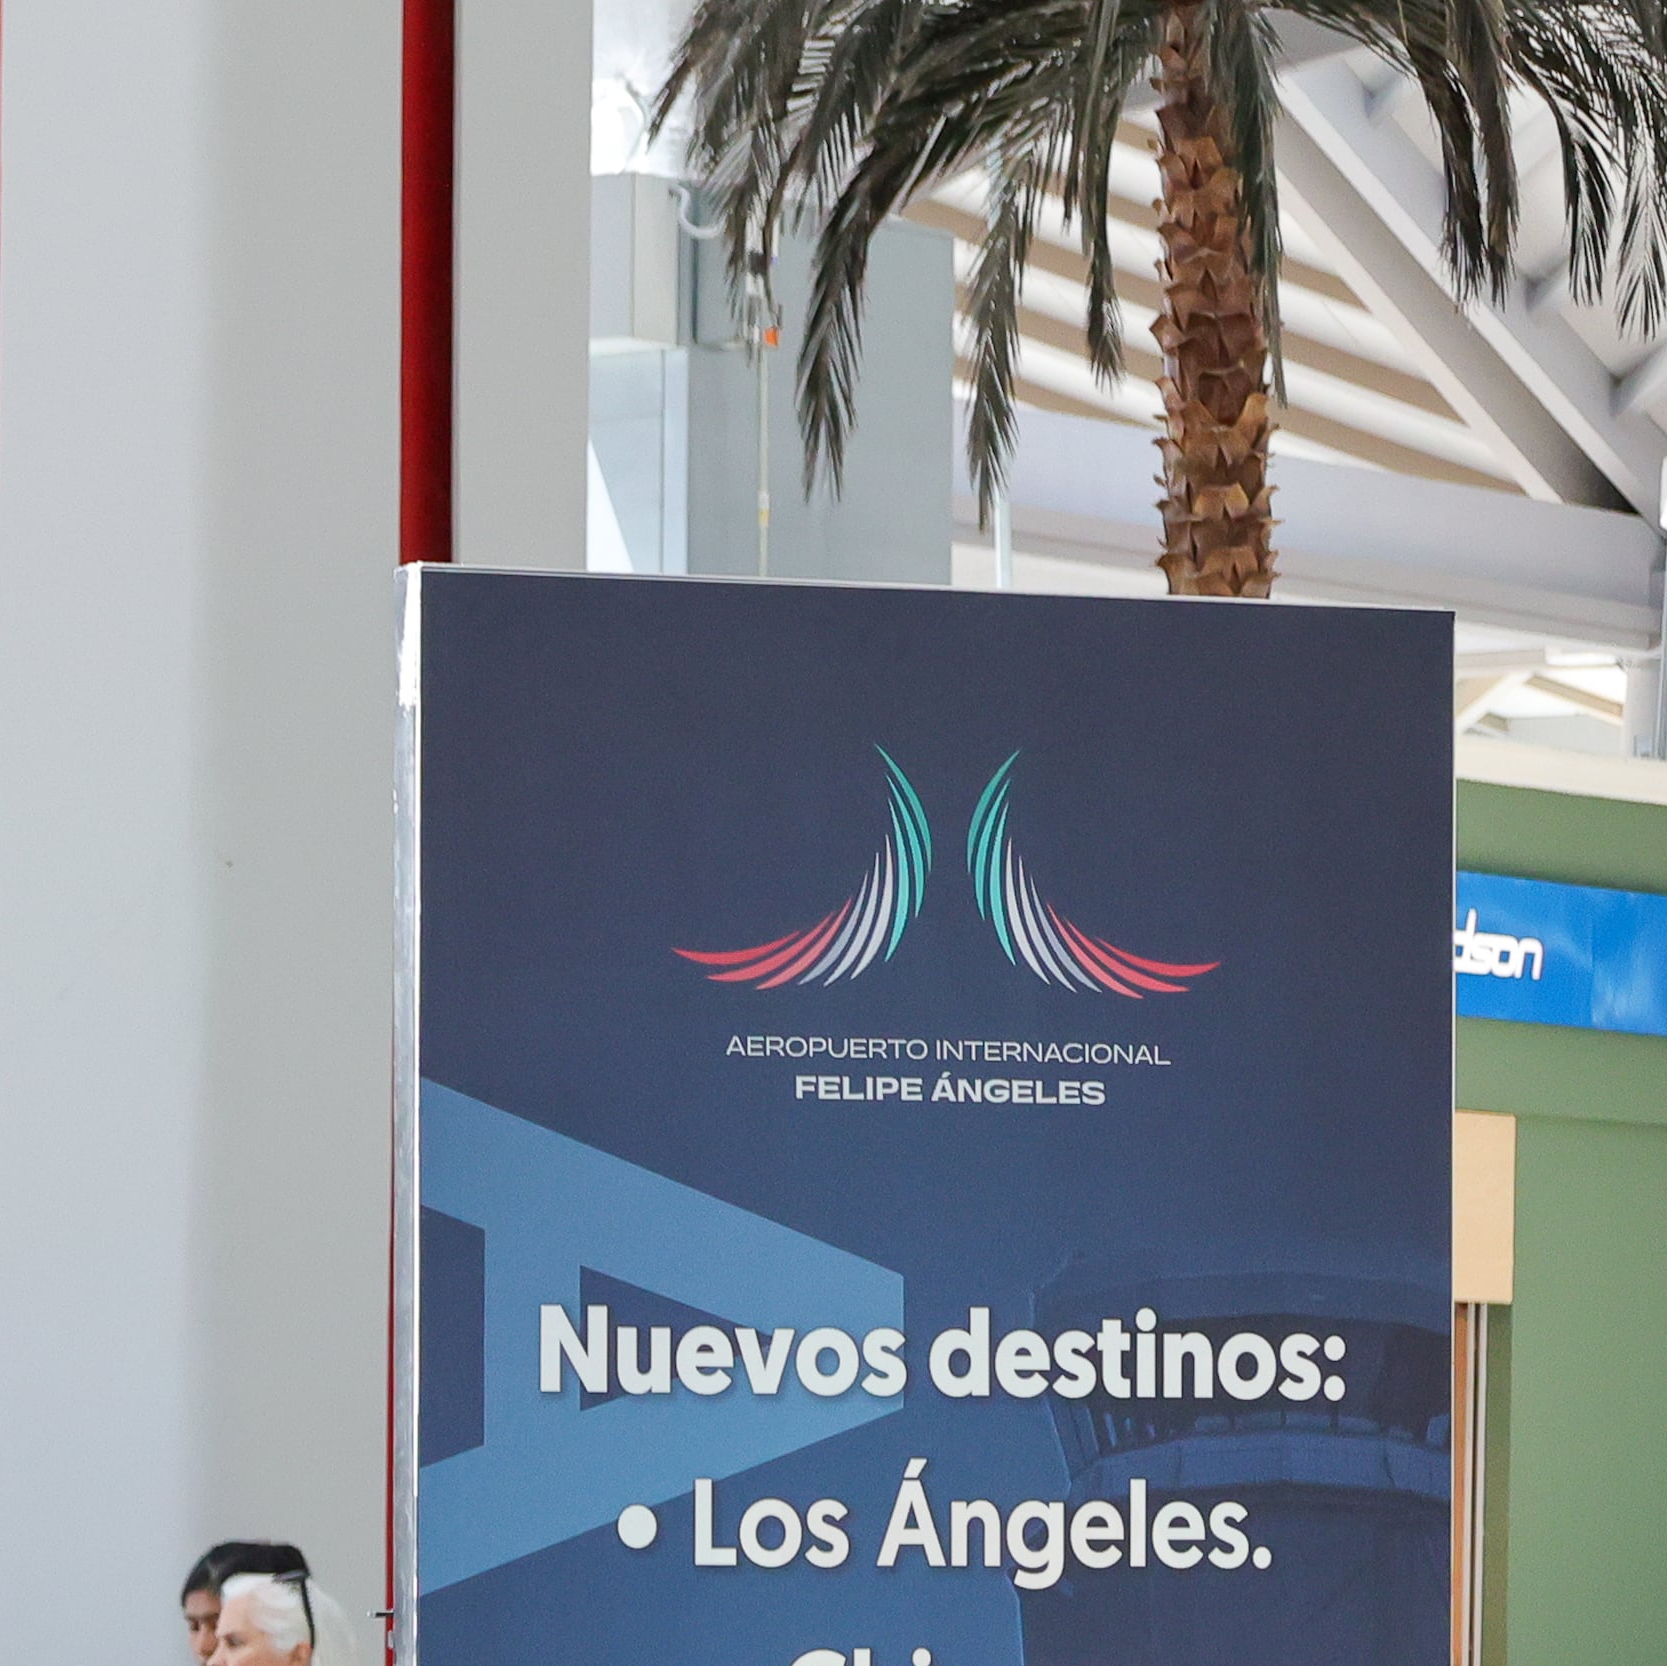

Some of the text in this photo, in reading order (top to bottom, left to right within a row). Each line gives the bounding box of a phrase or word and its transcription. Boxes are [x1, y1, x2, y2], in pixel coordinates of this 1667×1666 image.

[726, 1035, 1171, 1066] AEROPUERTO INTERNACIONAL
[795, 1071, 1106, 1105] FELIPE ÁNGELES
[541, 1306, 1345, 1401] Nuevos destinos:
[695, 1459, 1271, 1588] Los Ángeles.
